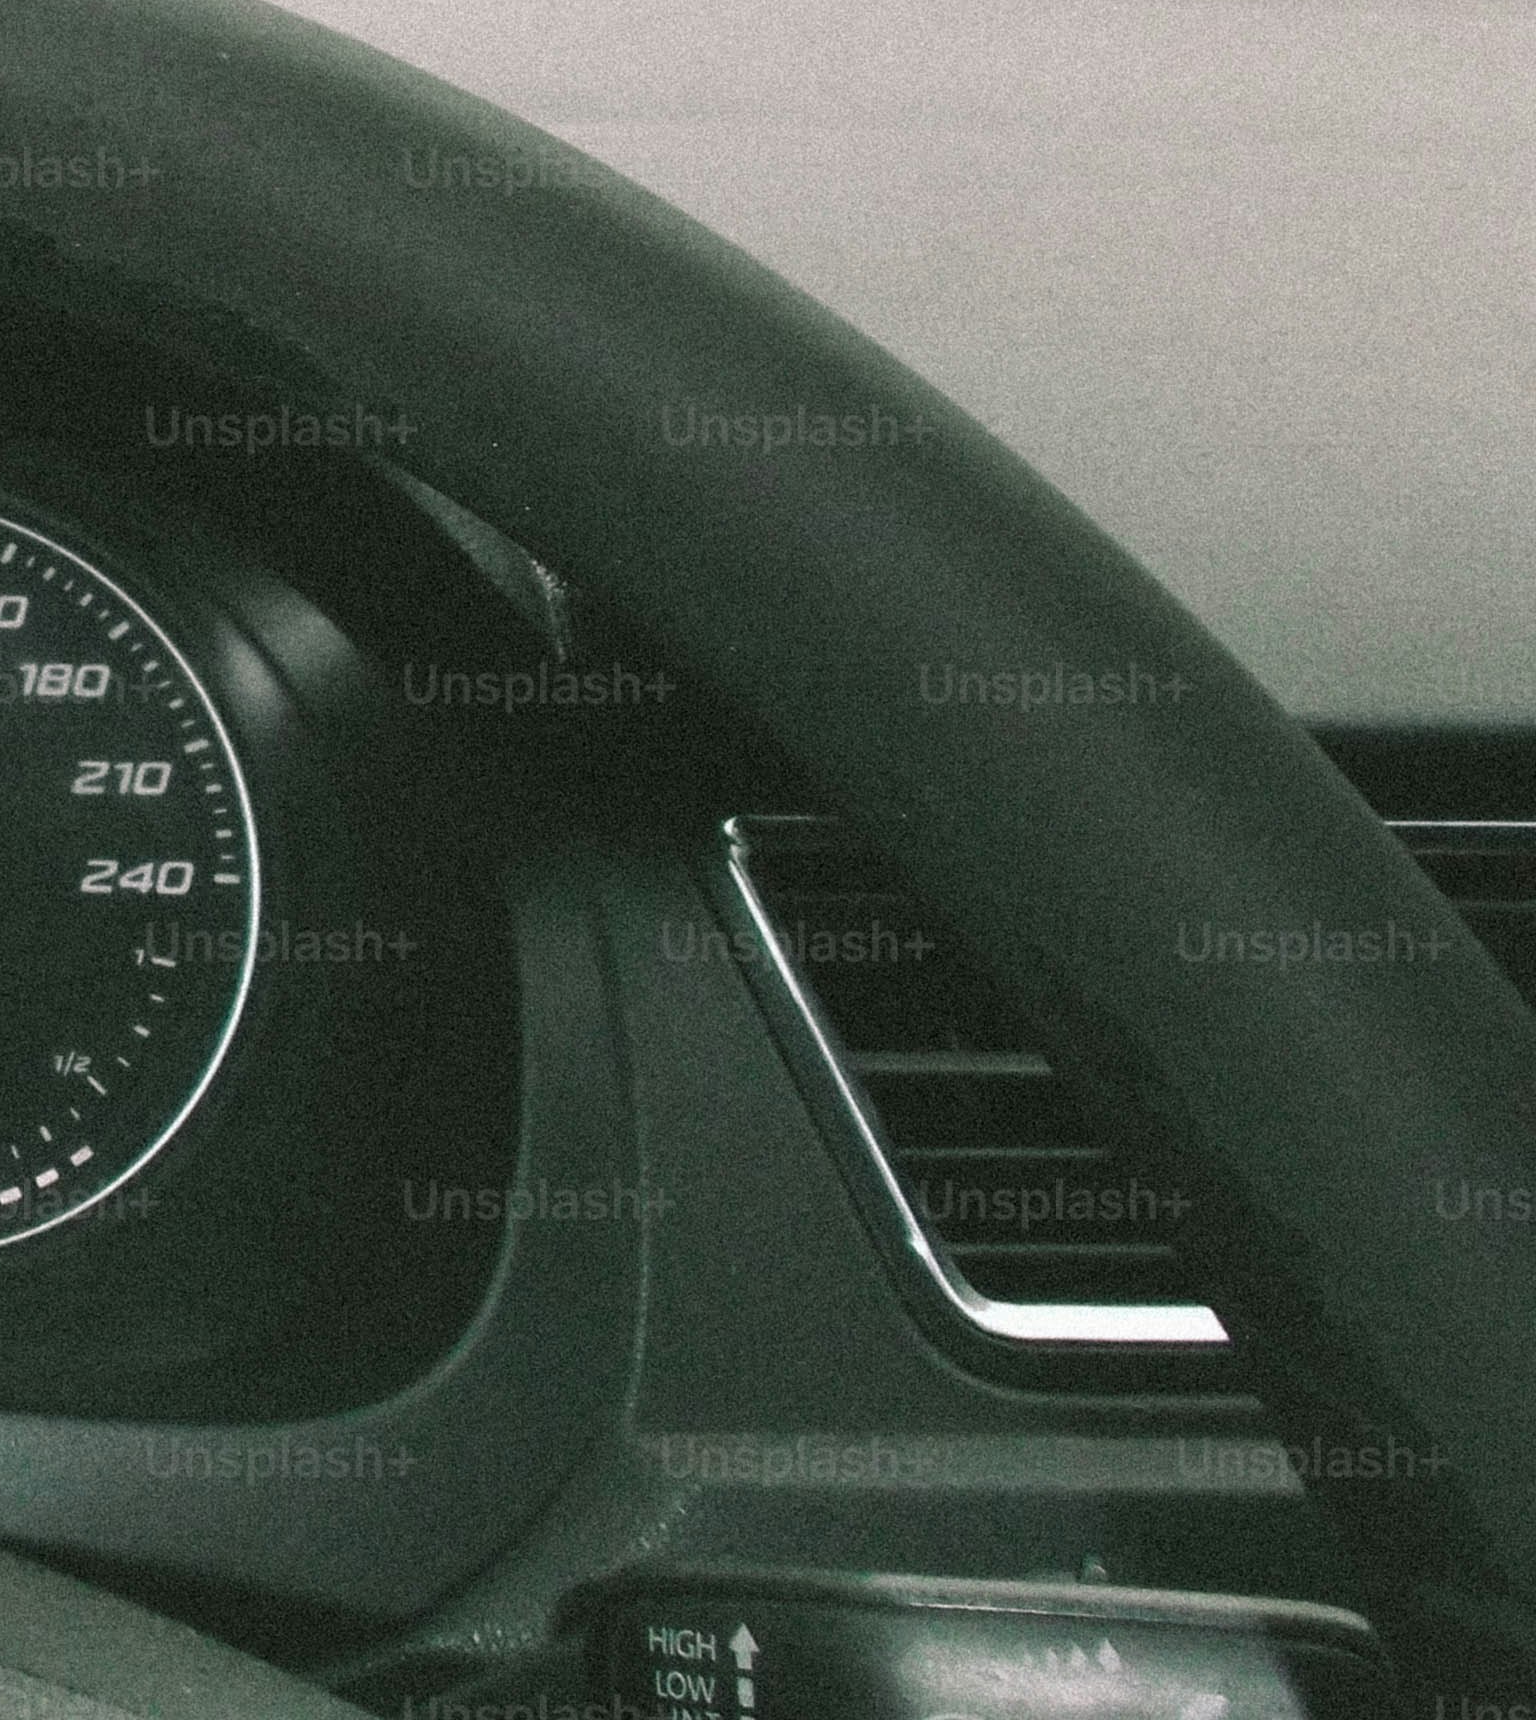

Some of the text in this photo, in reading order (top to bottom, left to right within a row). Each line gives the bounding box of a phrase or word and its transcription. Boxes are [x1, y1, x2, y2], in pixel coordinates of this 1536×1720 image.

[19, 662, 111, 698] 180
[71, 760, 172, 796] 210
[80, 859, 195, 895] 240
[135, 949, 145, 966] 1
[54, 1051, 92, 1076] 1/2
[648, 1626, 717, 1662] HIGH
[655, 1670, 716, 1705] LOW
